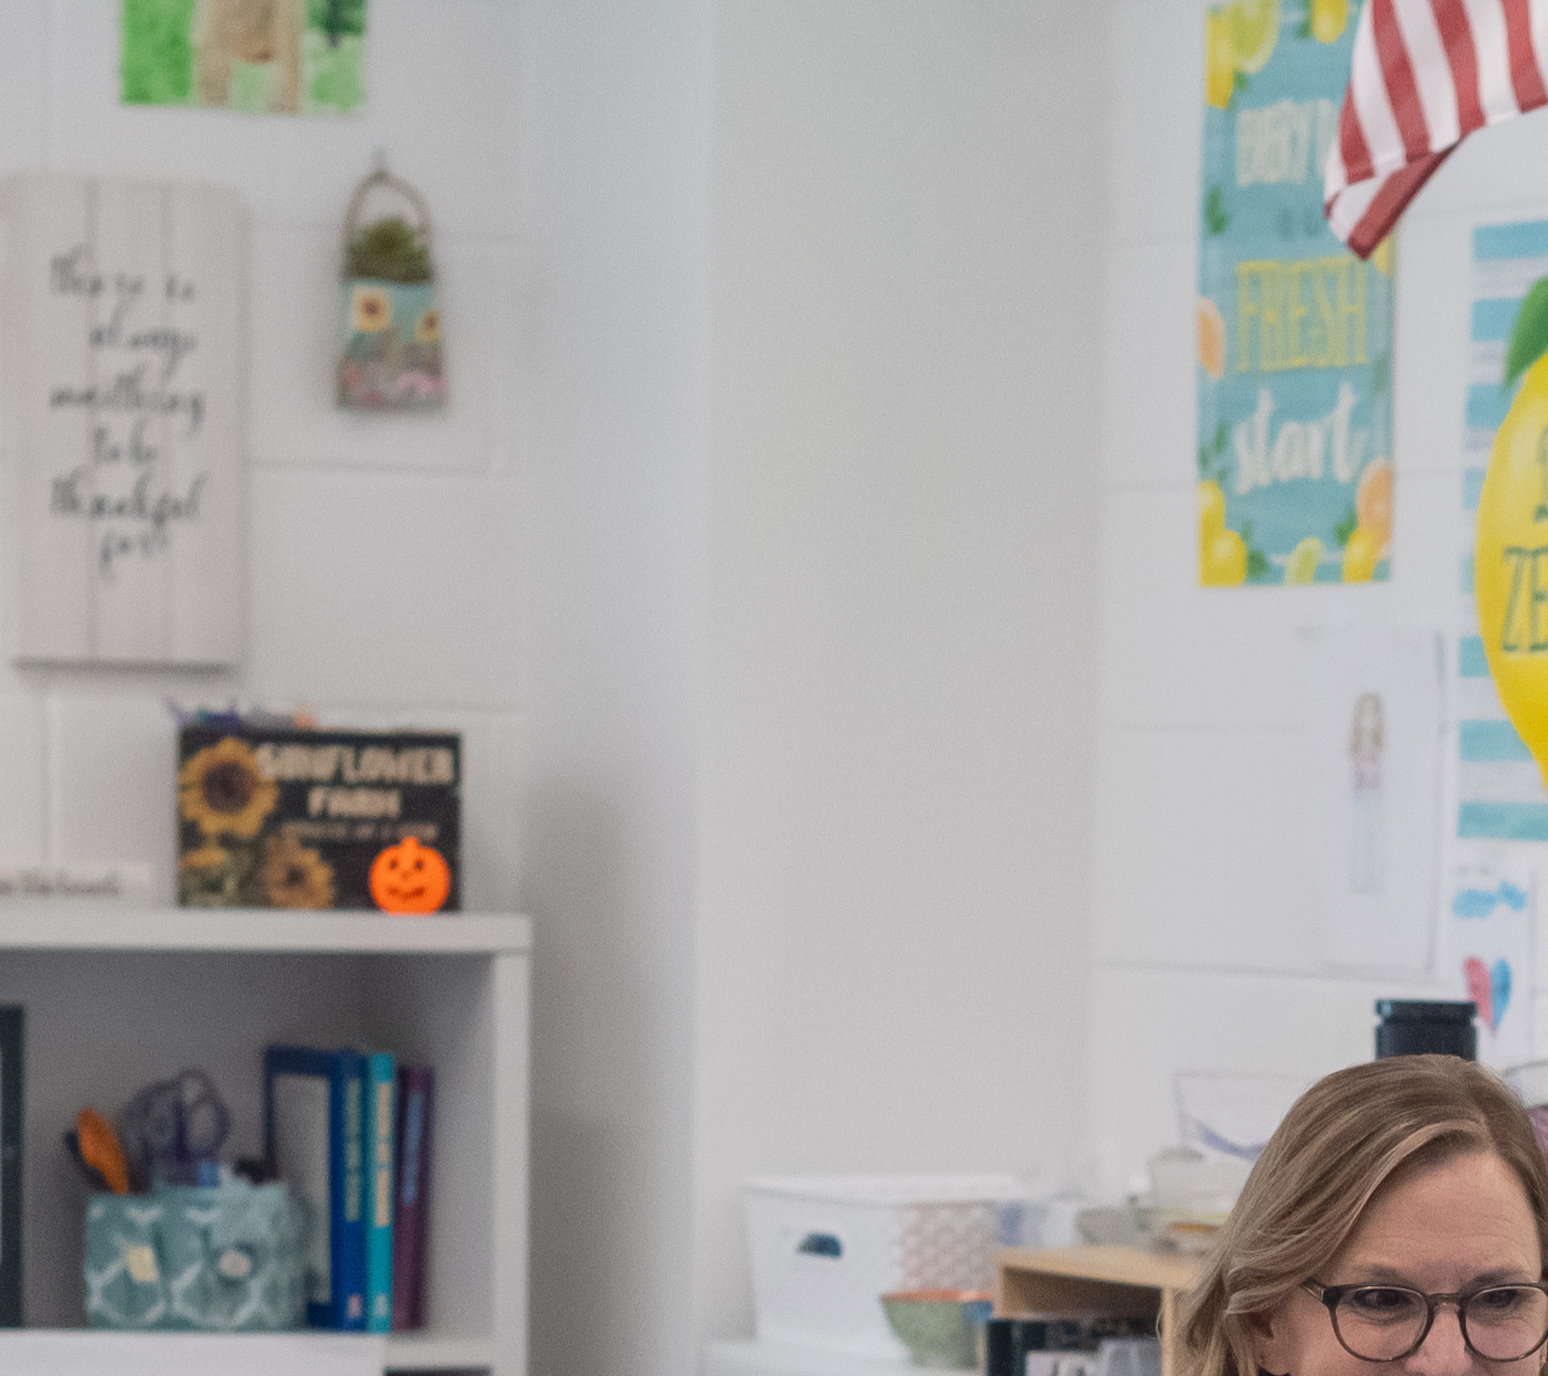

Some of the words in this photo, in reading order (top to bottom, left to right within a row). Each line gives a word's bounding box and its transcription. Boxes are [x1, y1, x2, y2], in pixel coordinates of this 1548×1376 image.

[1236, 256, 1370, 373] FRESH
[1233, 385, 1365, 497] start
[256, 742, 454, 784] SUNFLOWER
[306, 787, 402, 819] FARM
